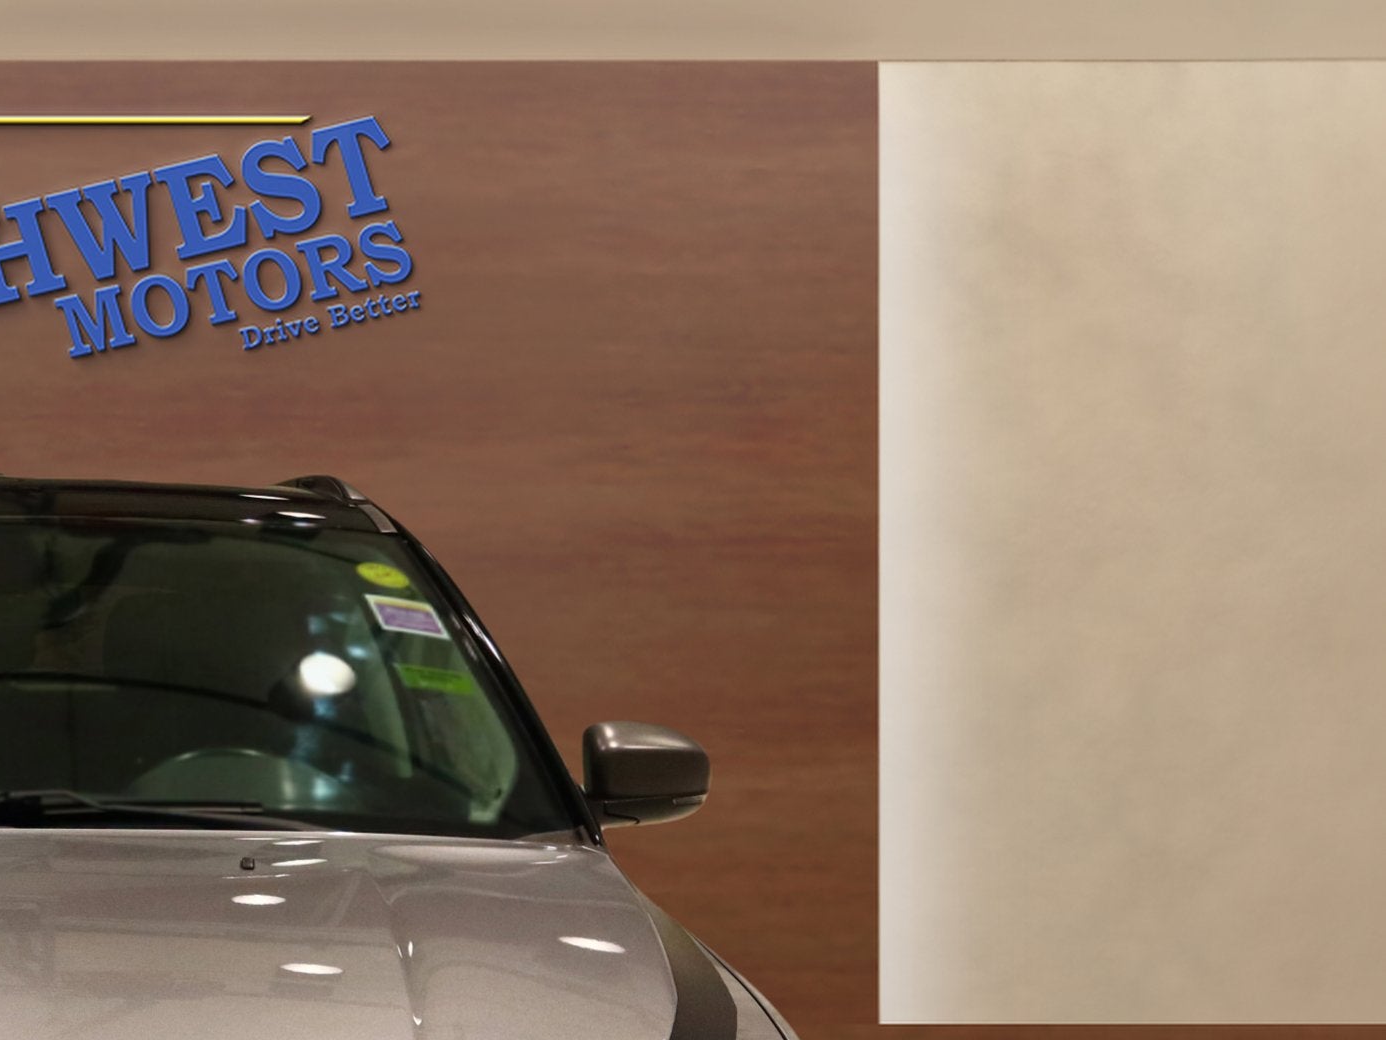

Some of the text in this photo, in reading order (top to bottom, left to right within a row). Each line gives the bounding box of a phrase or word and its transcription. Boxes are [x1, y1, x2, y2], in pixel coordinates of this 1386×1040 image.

[54, 221, 414, 358] MOTORS
[239, 290, 421, 350] Drive Better
